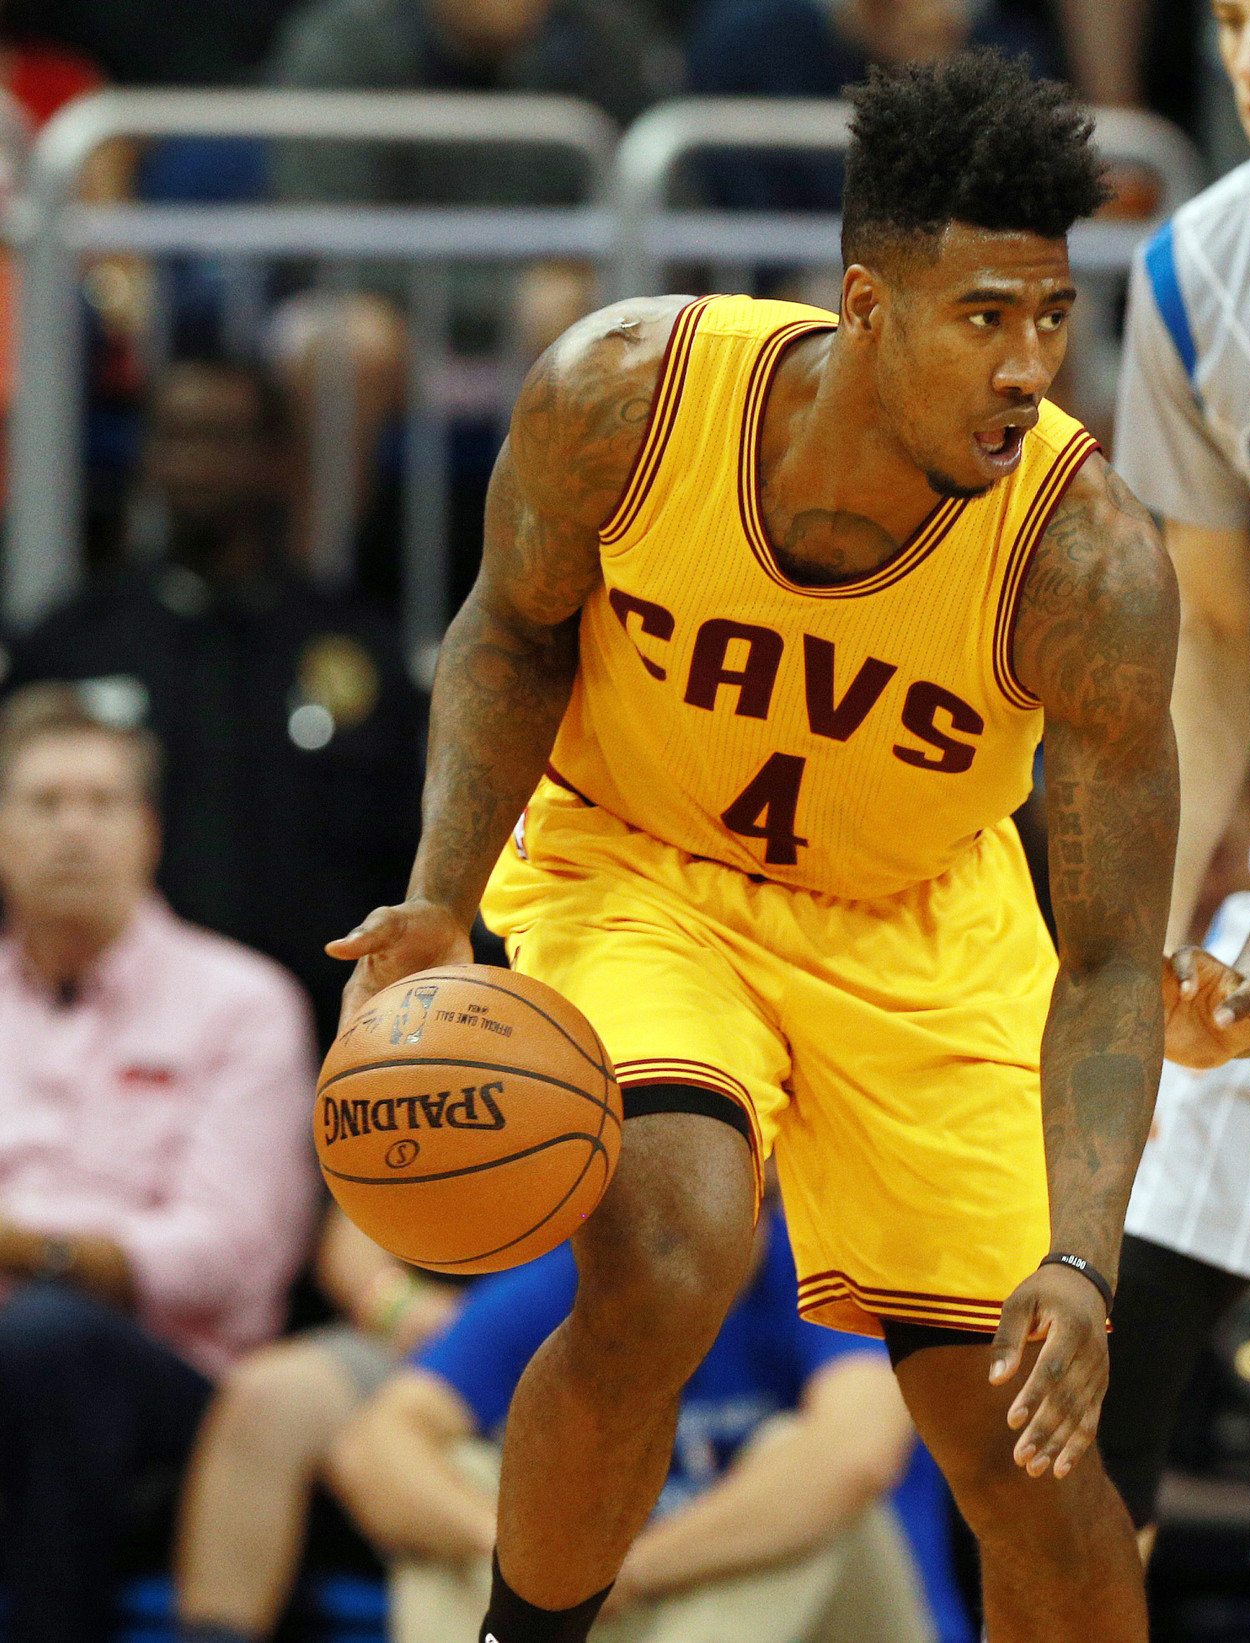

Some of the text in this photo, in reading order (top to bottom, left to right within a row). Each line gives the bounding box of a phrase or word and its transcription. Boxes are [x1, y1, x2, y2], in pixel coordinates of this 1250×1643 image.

[608, 587, 985, 774] CAVS
[720, 751, 809, 866] 4
[435, 1010, 513, 1038] OFFICIAL GAME BALL
[324, 1081, 506, 1146] SPALDING
